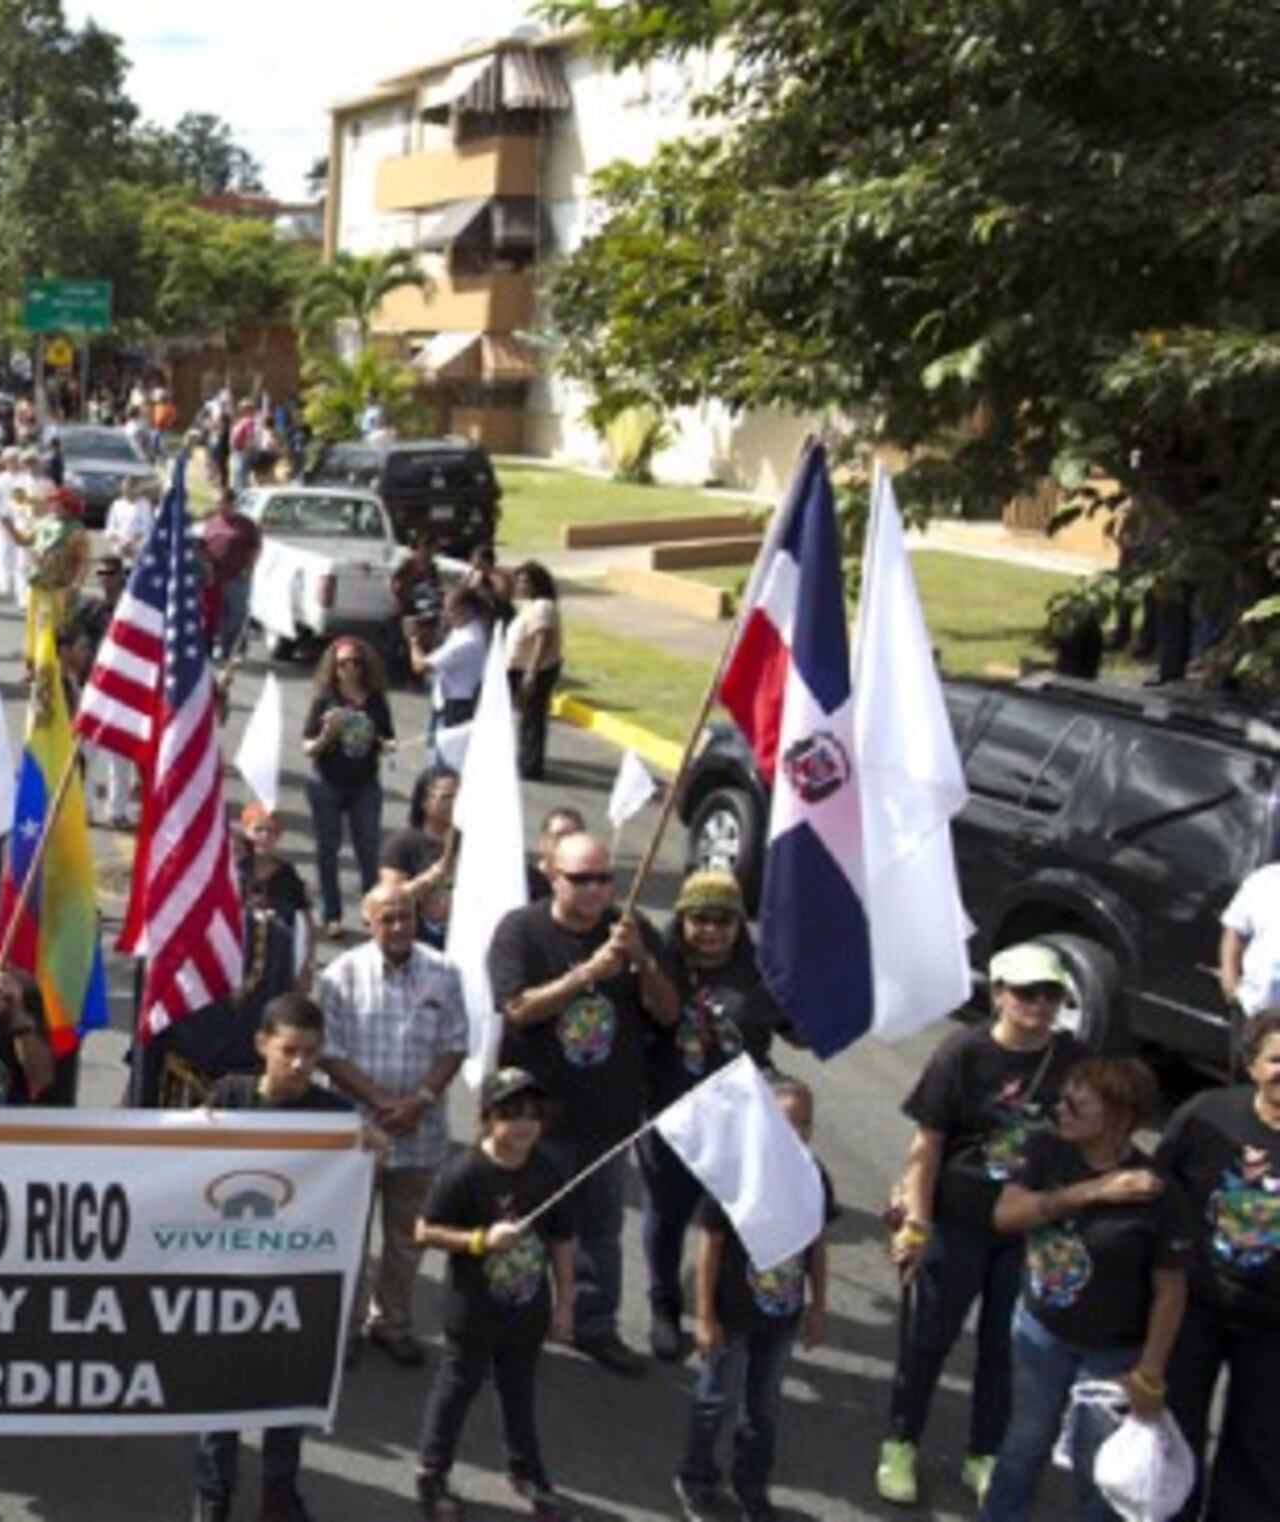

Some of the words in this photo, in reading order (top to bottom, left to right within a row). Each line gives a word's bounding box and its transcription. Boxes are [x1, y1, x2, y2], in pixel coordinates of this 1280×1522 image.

[26, 1182, 129, 1262] RICO
[152, 1229, 337, 1251] VIVIENDA
[50, 1287, 126, 1333] LA
[149, 1288, 302, 1334] VIDA
